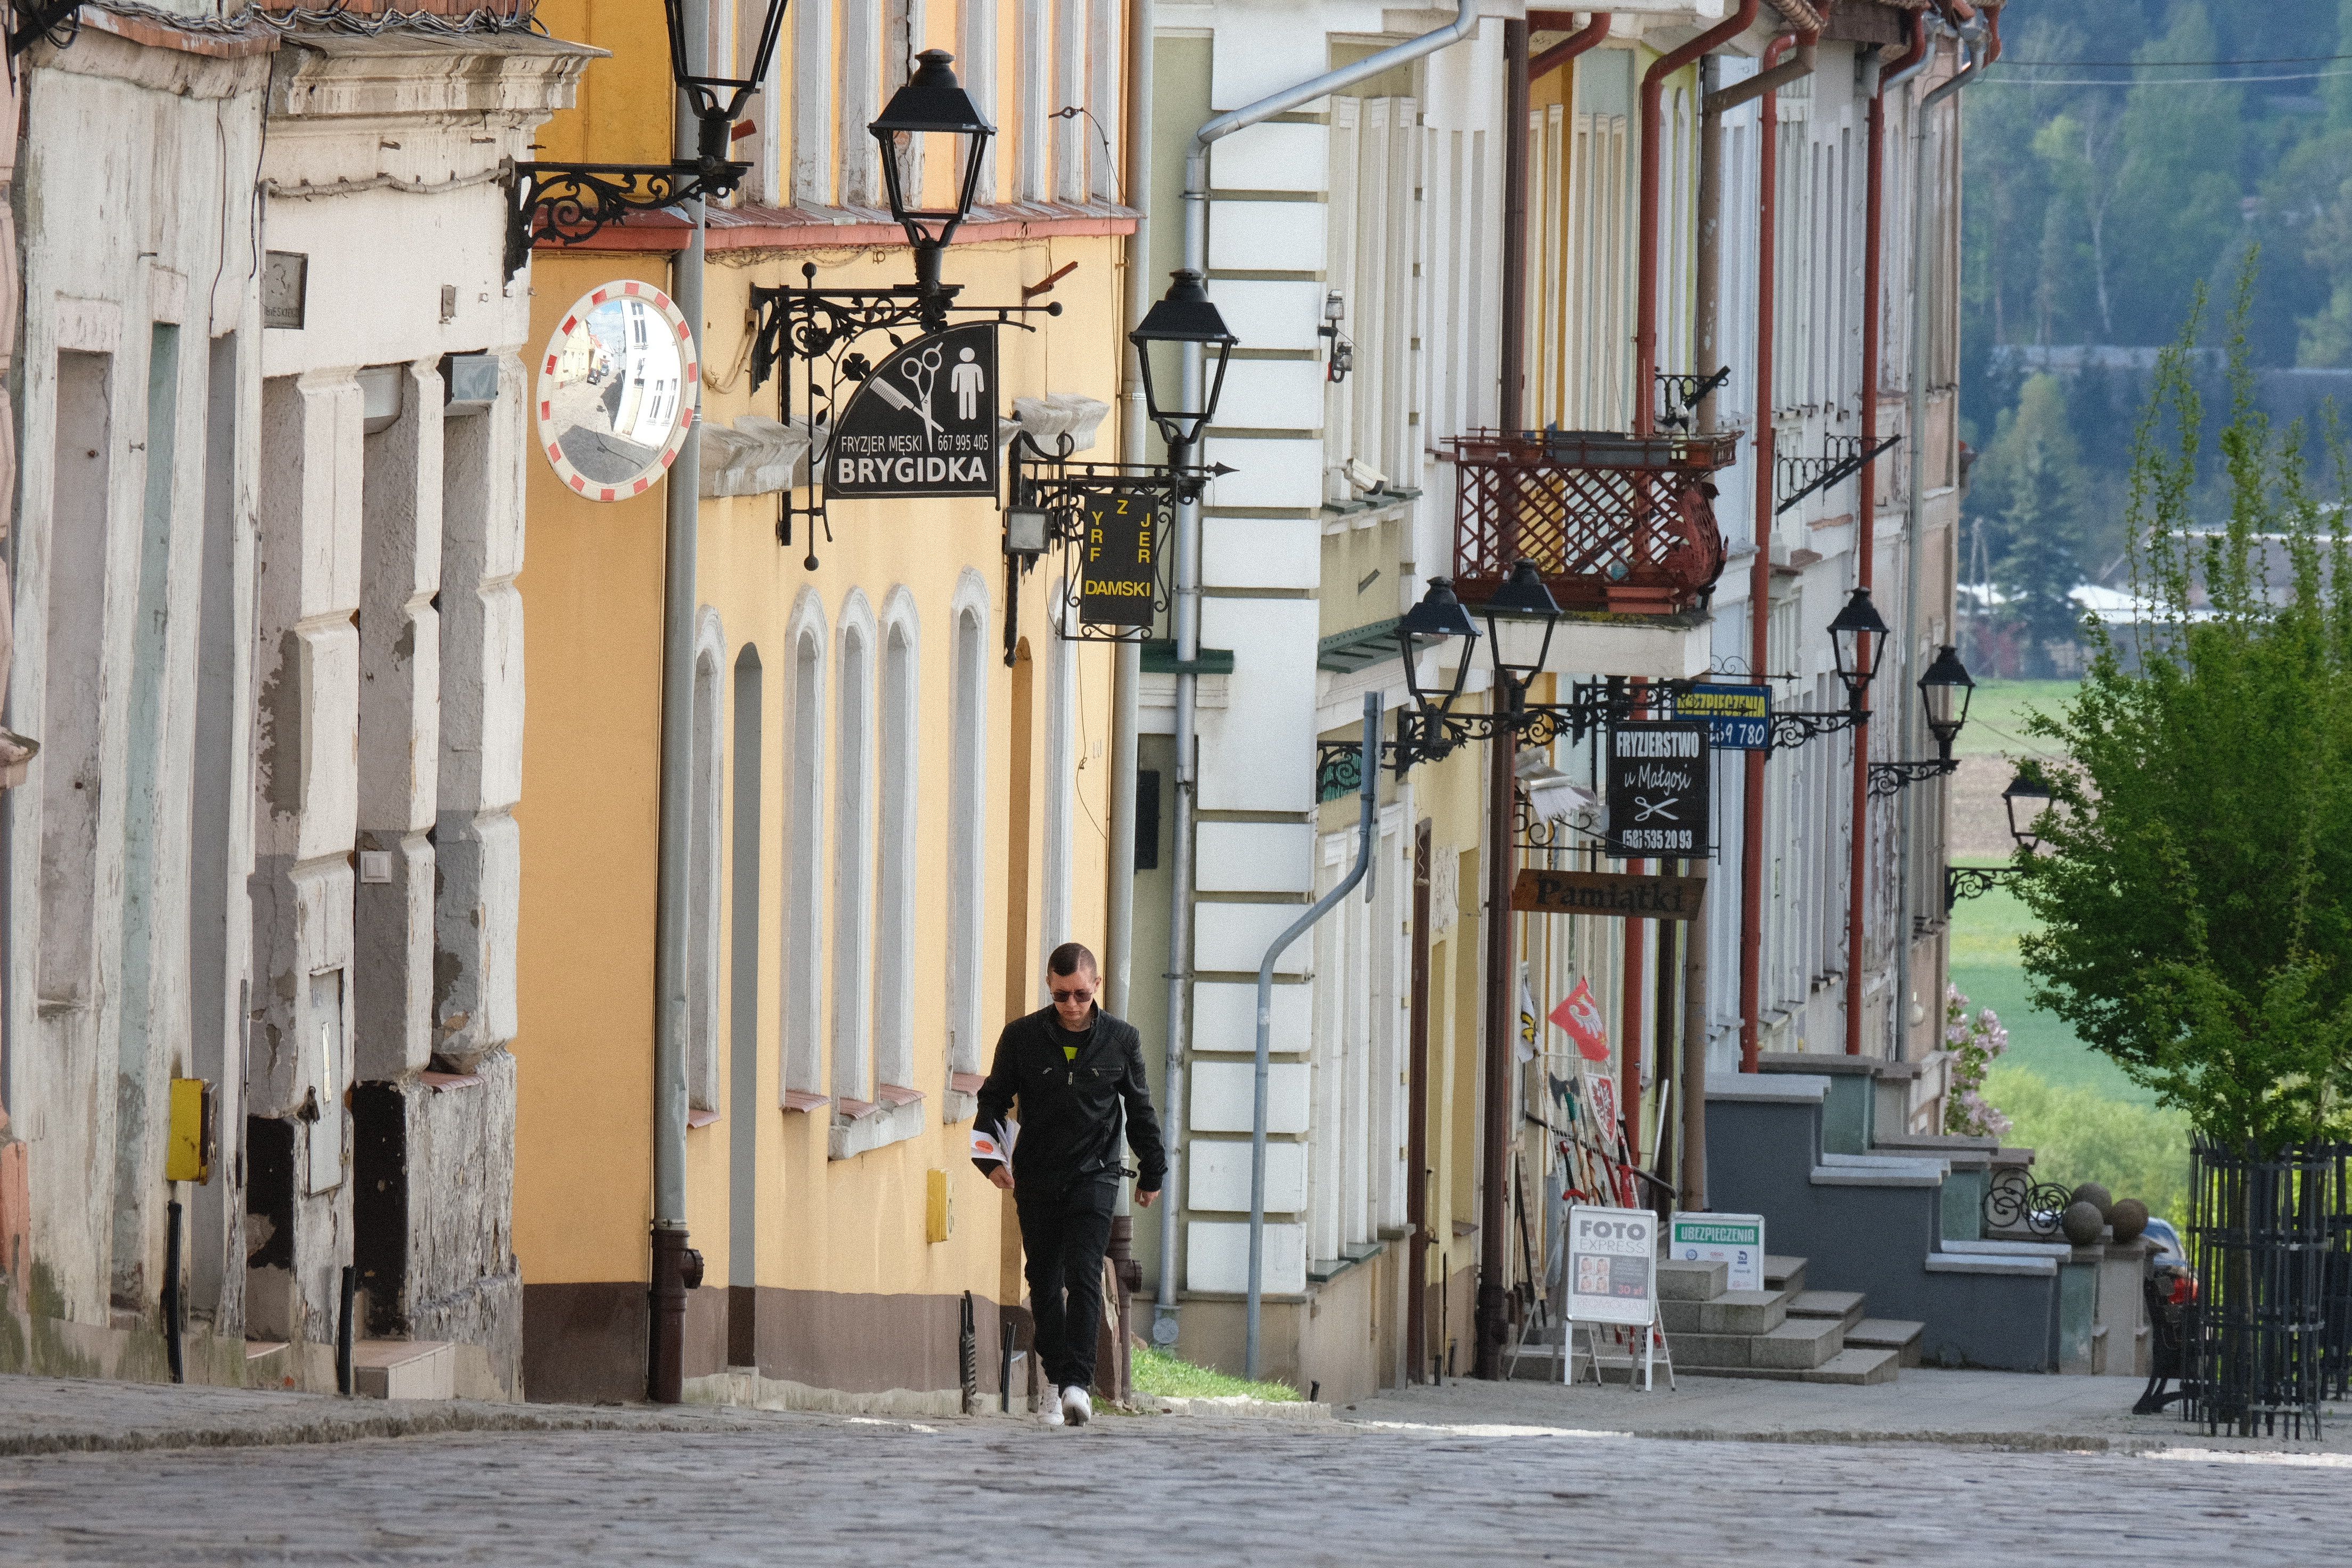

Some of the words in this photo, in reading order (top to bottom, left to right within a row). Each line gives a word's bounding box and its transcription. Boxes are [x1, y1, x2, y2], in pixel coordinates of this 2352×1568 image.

[841, 435, 885, 456] FRYZJER
[889, 435, 922, 456] MĘSKI
[938, 435, 953, 451] 667
[956, 435, 971, 451] 995
[973, 434, 989, 451] 405
[838, 456, 987, 484] BRYGIDKA
[1085, 580, 1150, 597] DAMSKI
[1738, 723, 1765, 745] 780
[1616, 731, 1700, 758] FRYZJERSTWO
[1625, 772, 1636, 788] u
[1644, 829, 1663, 849] 535
[1664, 829, 1678, 849] 20
[1679, 829, 1693, 849] 93
[1580, 1220, 1646, 1241] FOTO
[1680, 1226, 1755, 1243] UBEZPIECZENIA
[1580, 1239, 1646, 1253] EXPRESS
[1617, 1284, 1631, 1295] 30
